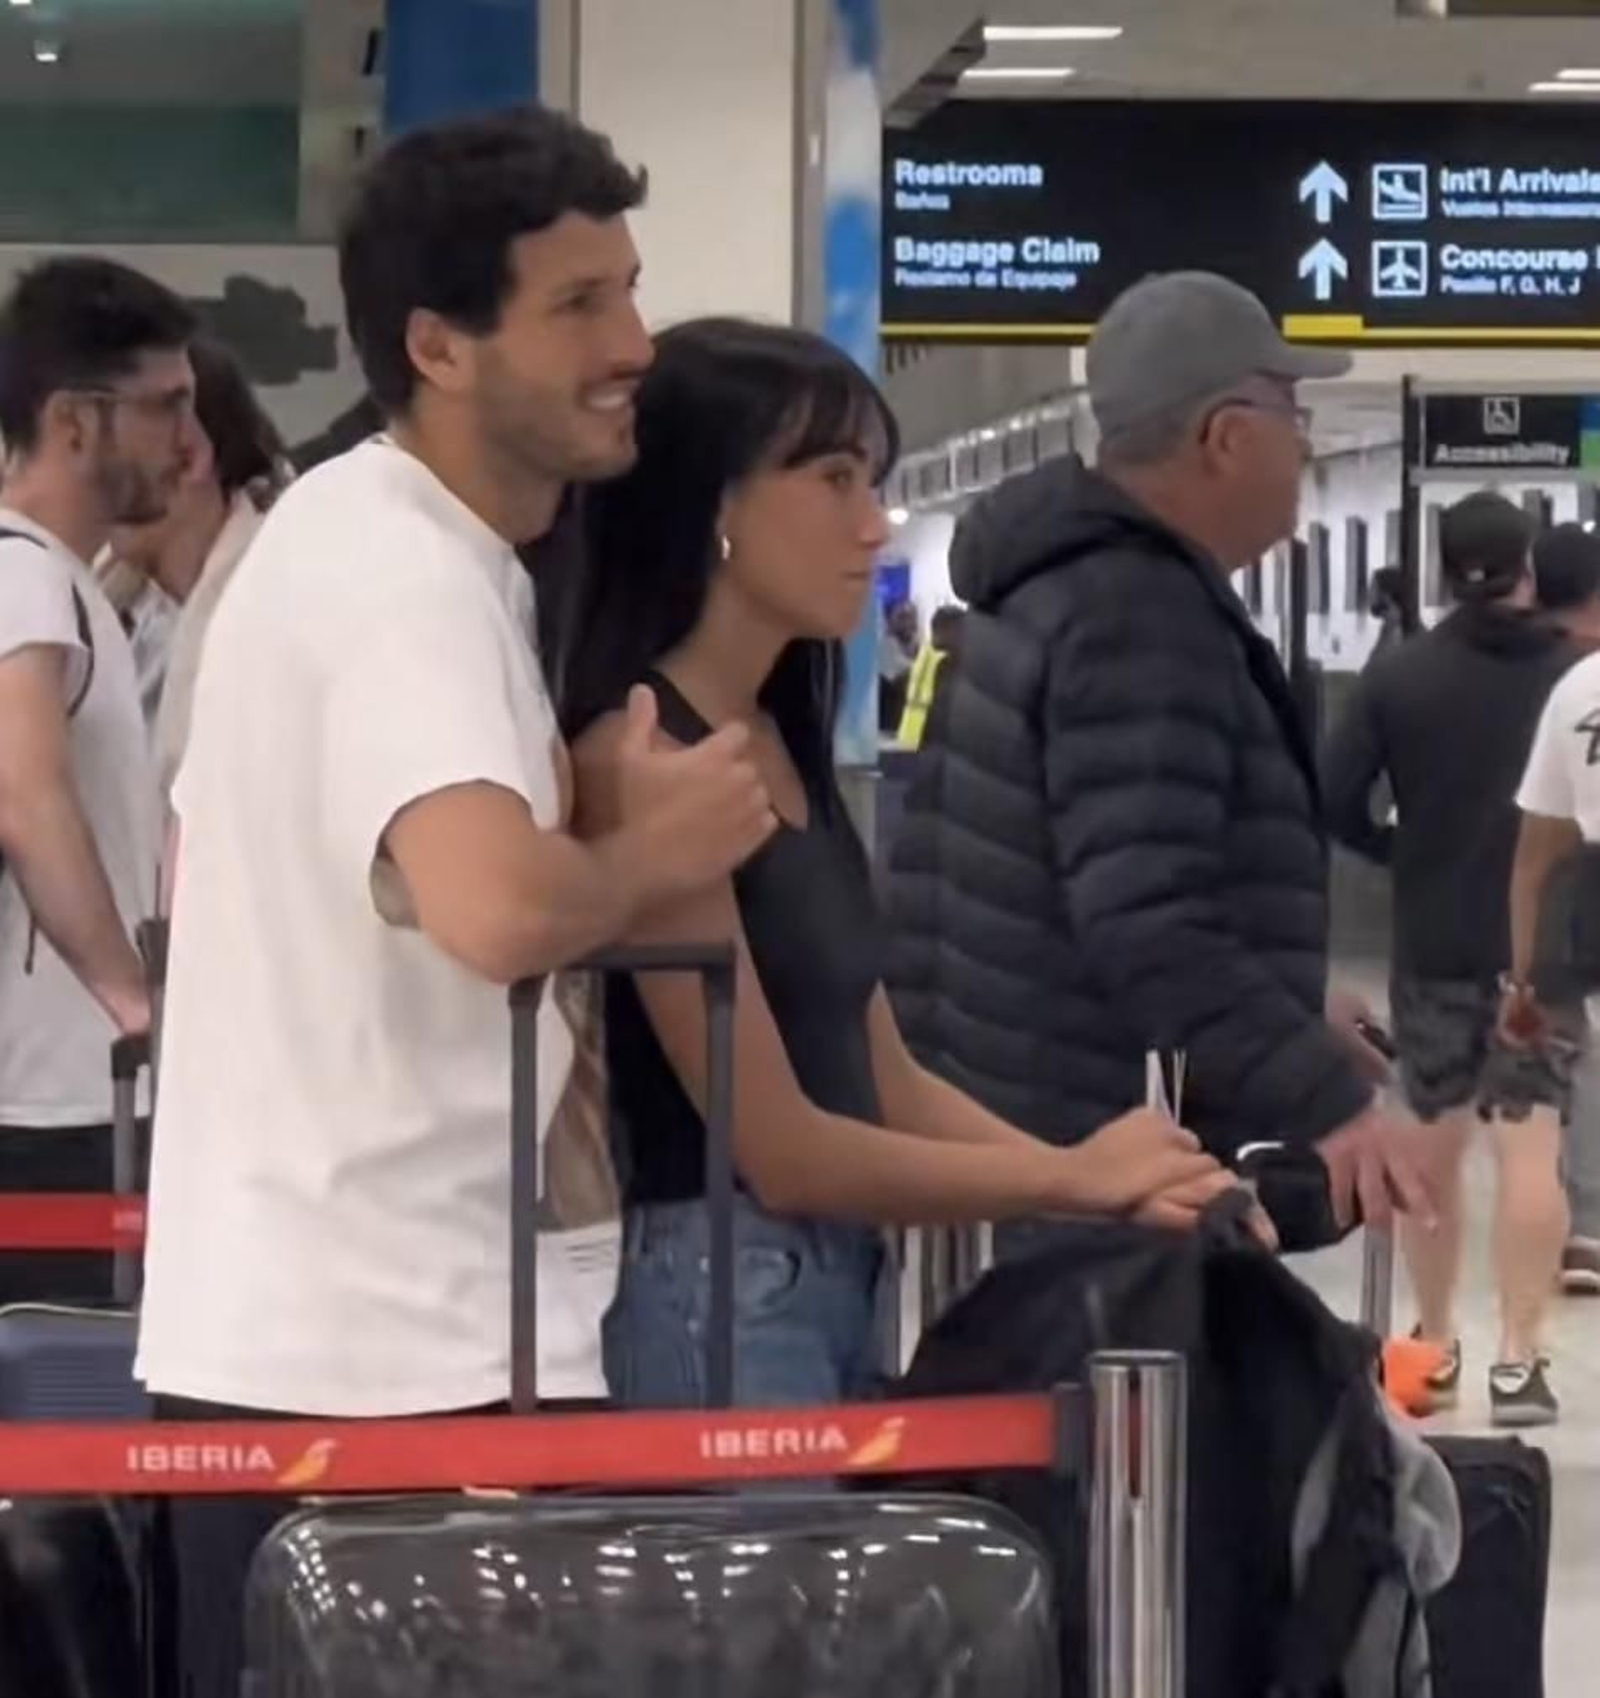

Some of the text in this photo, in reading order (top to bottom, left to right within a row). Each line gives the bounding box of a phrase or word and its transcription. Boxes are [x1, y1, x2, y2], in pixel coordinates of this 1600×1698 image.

[895, 159, 1043, 186] Restrooms
[1440, 167, 1491, 193] Int'l
[895, 237, 1100, 267] Baggage Claim
[1440, 243, 1588, 271] Concourse
[1568, 275, 1581, 295] J
[1434, 442, 1570, 466] Accessibility
[701, 1424, 848, 1459] IBERIA
[126, 1443, 276, 1472] IBERIA
